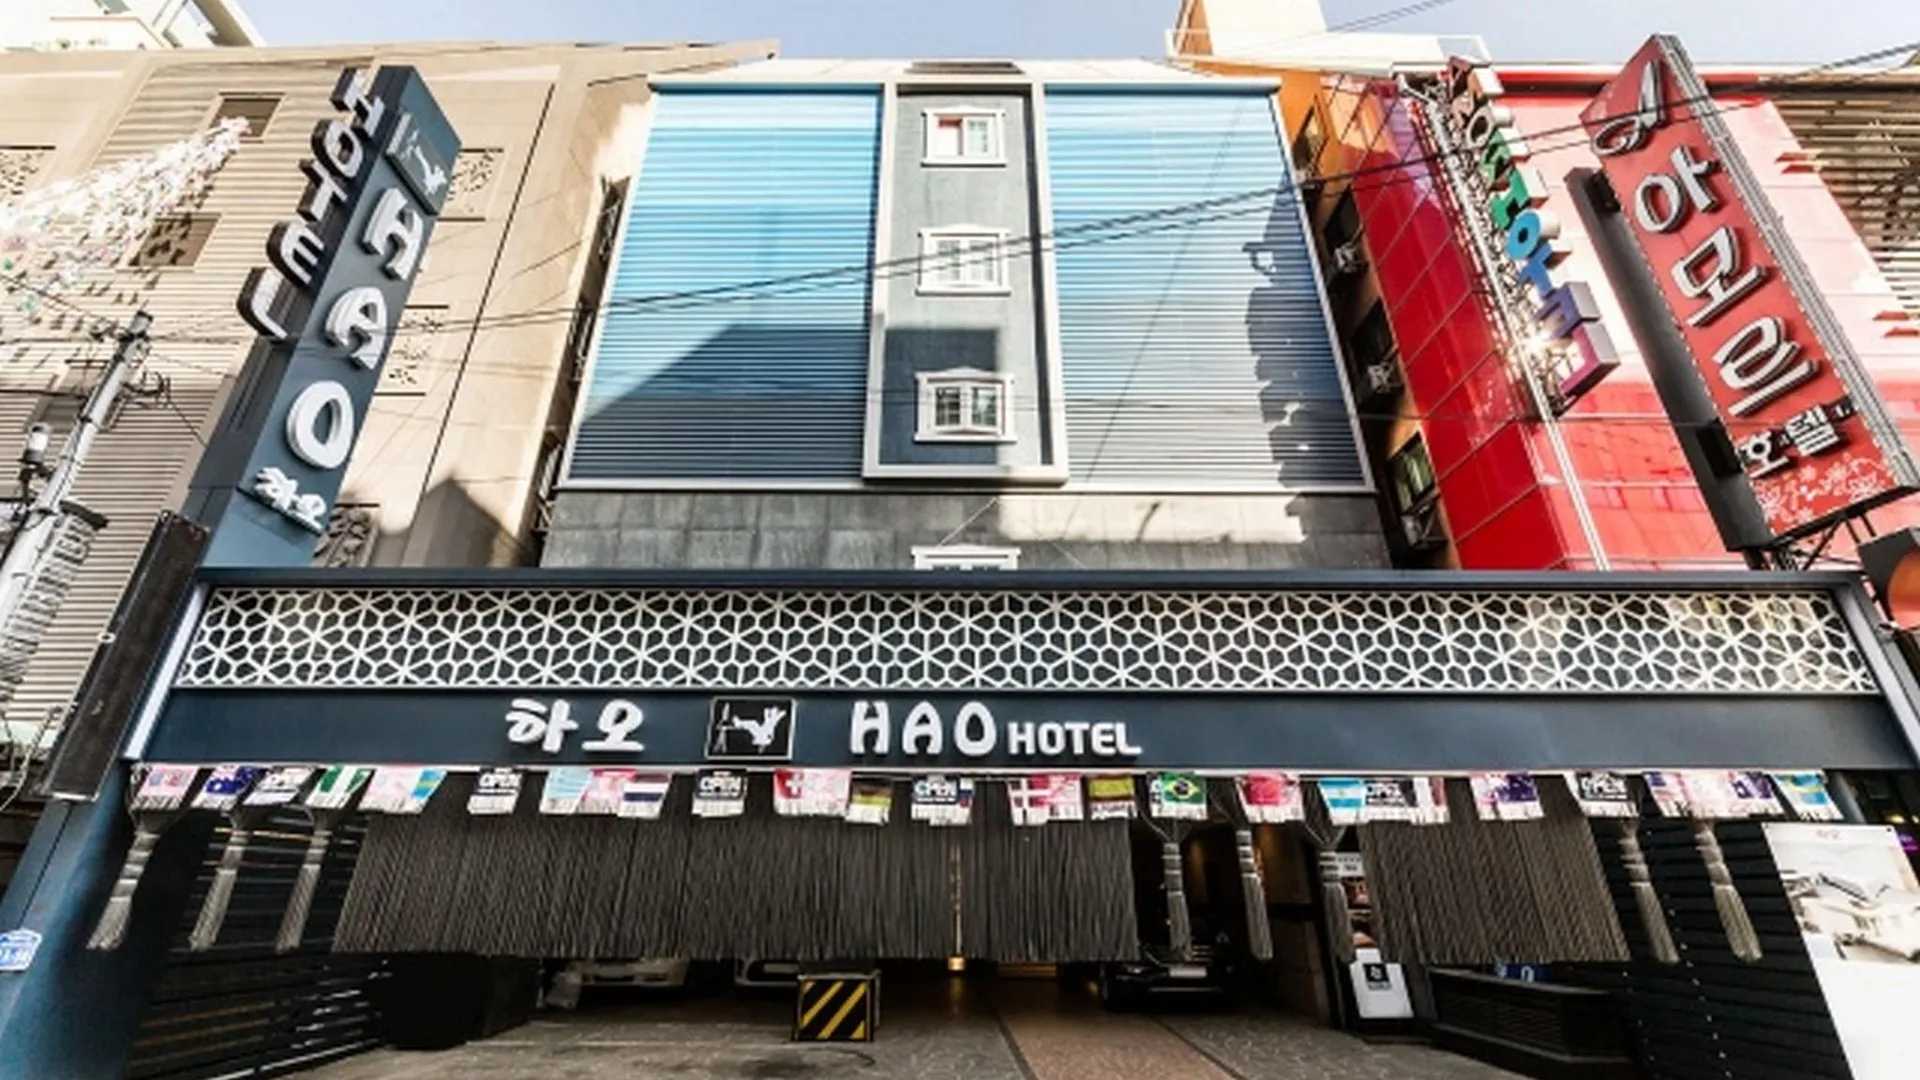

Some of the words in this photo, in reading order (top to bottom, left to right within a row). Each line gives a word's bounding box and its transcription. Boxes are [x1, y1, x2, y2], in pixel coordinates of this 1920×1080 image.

[240, 66, 385, 341] HOTEL
[1634, 145, 1815, 417] 아모르
[287, 187, 424, 470] HAO
[1740, 404, 1840, 478] 호텔
[254, 466, 327, 534] 하오
[505, 698, 645, 753] 하오
[851, 700, 997, 756] HAO
[1007, 721, 1143, 755] HOTEL
